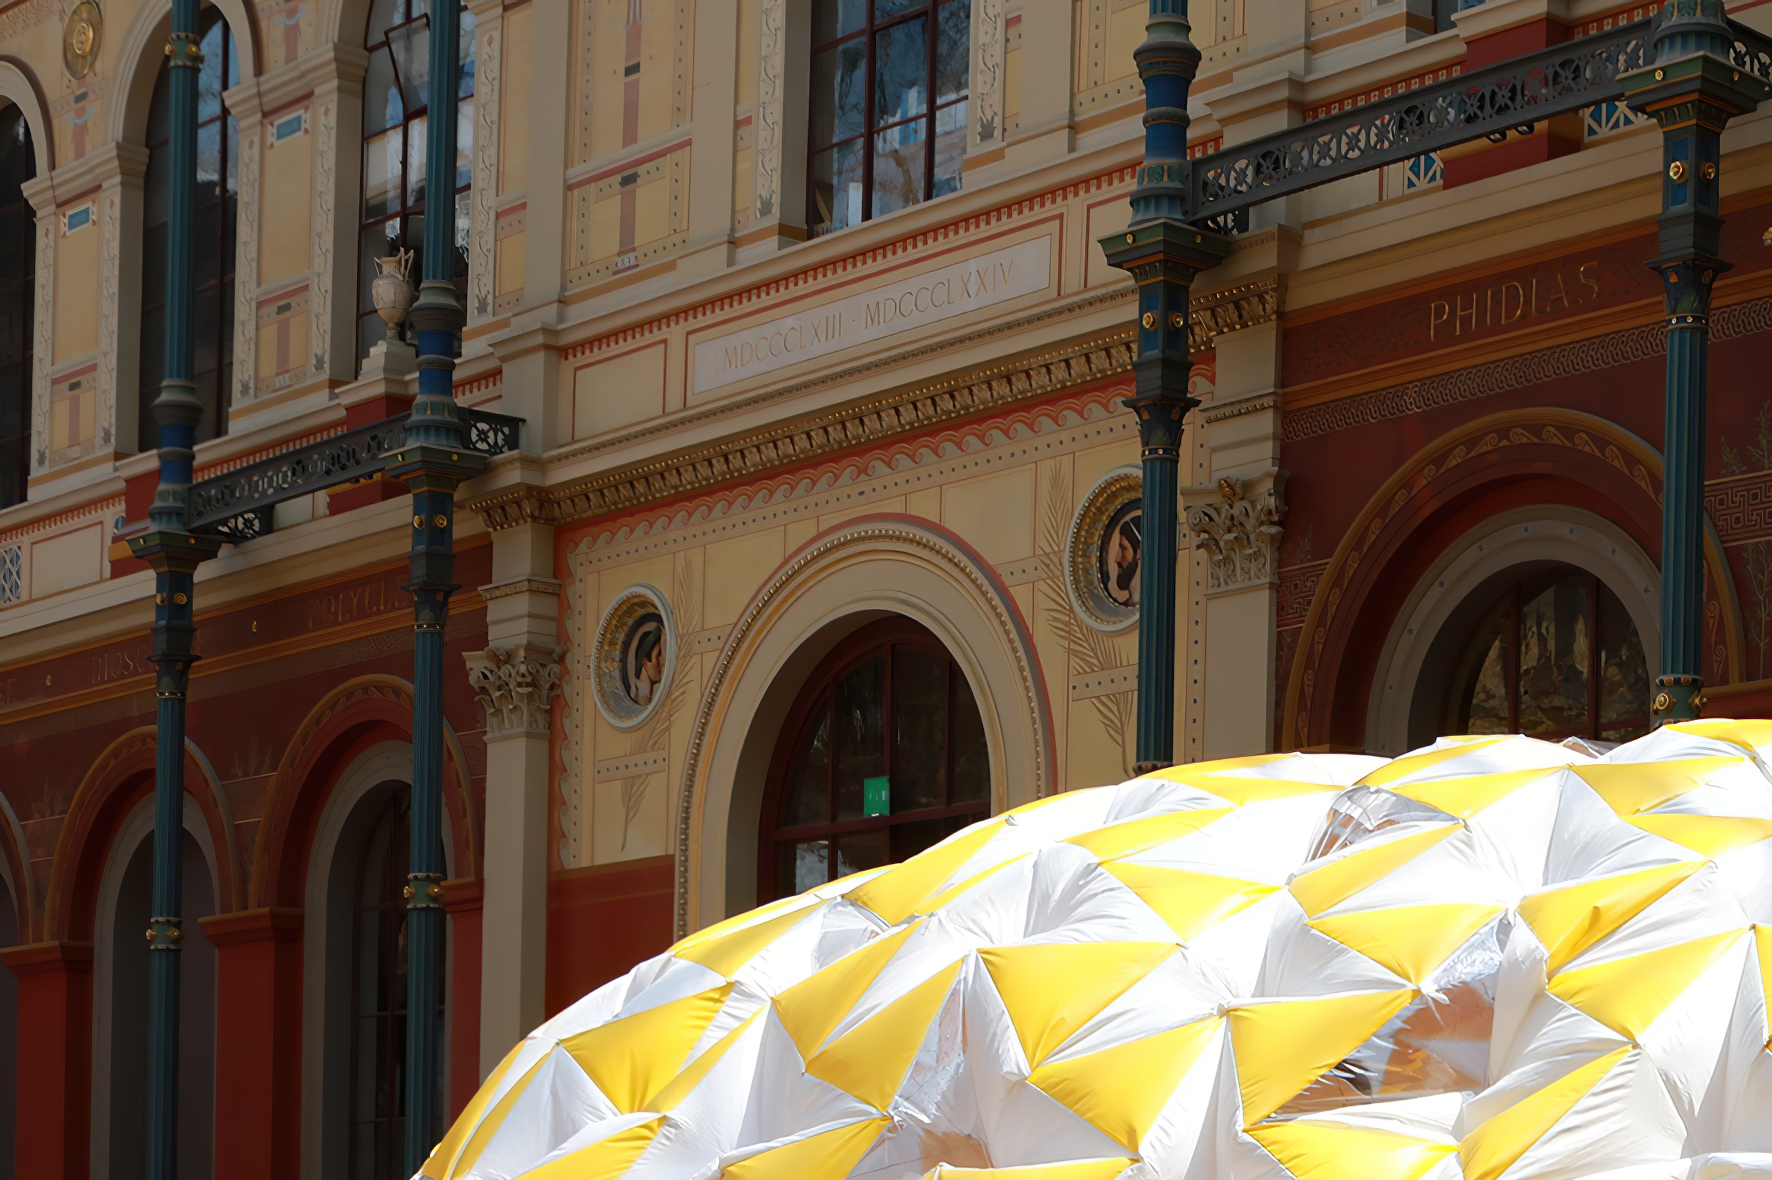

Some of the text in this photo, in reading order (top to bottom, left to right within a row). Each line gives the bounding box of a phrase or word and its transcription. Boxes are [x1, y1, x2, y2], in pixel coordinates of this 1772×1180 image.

[723, 259, 1014, 372] MDCCCLXIII MDCCCLXXIV
[1429, 260, 1600, 342] PHIDIAS
